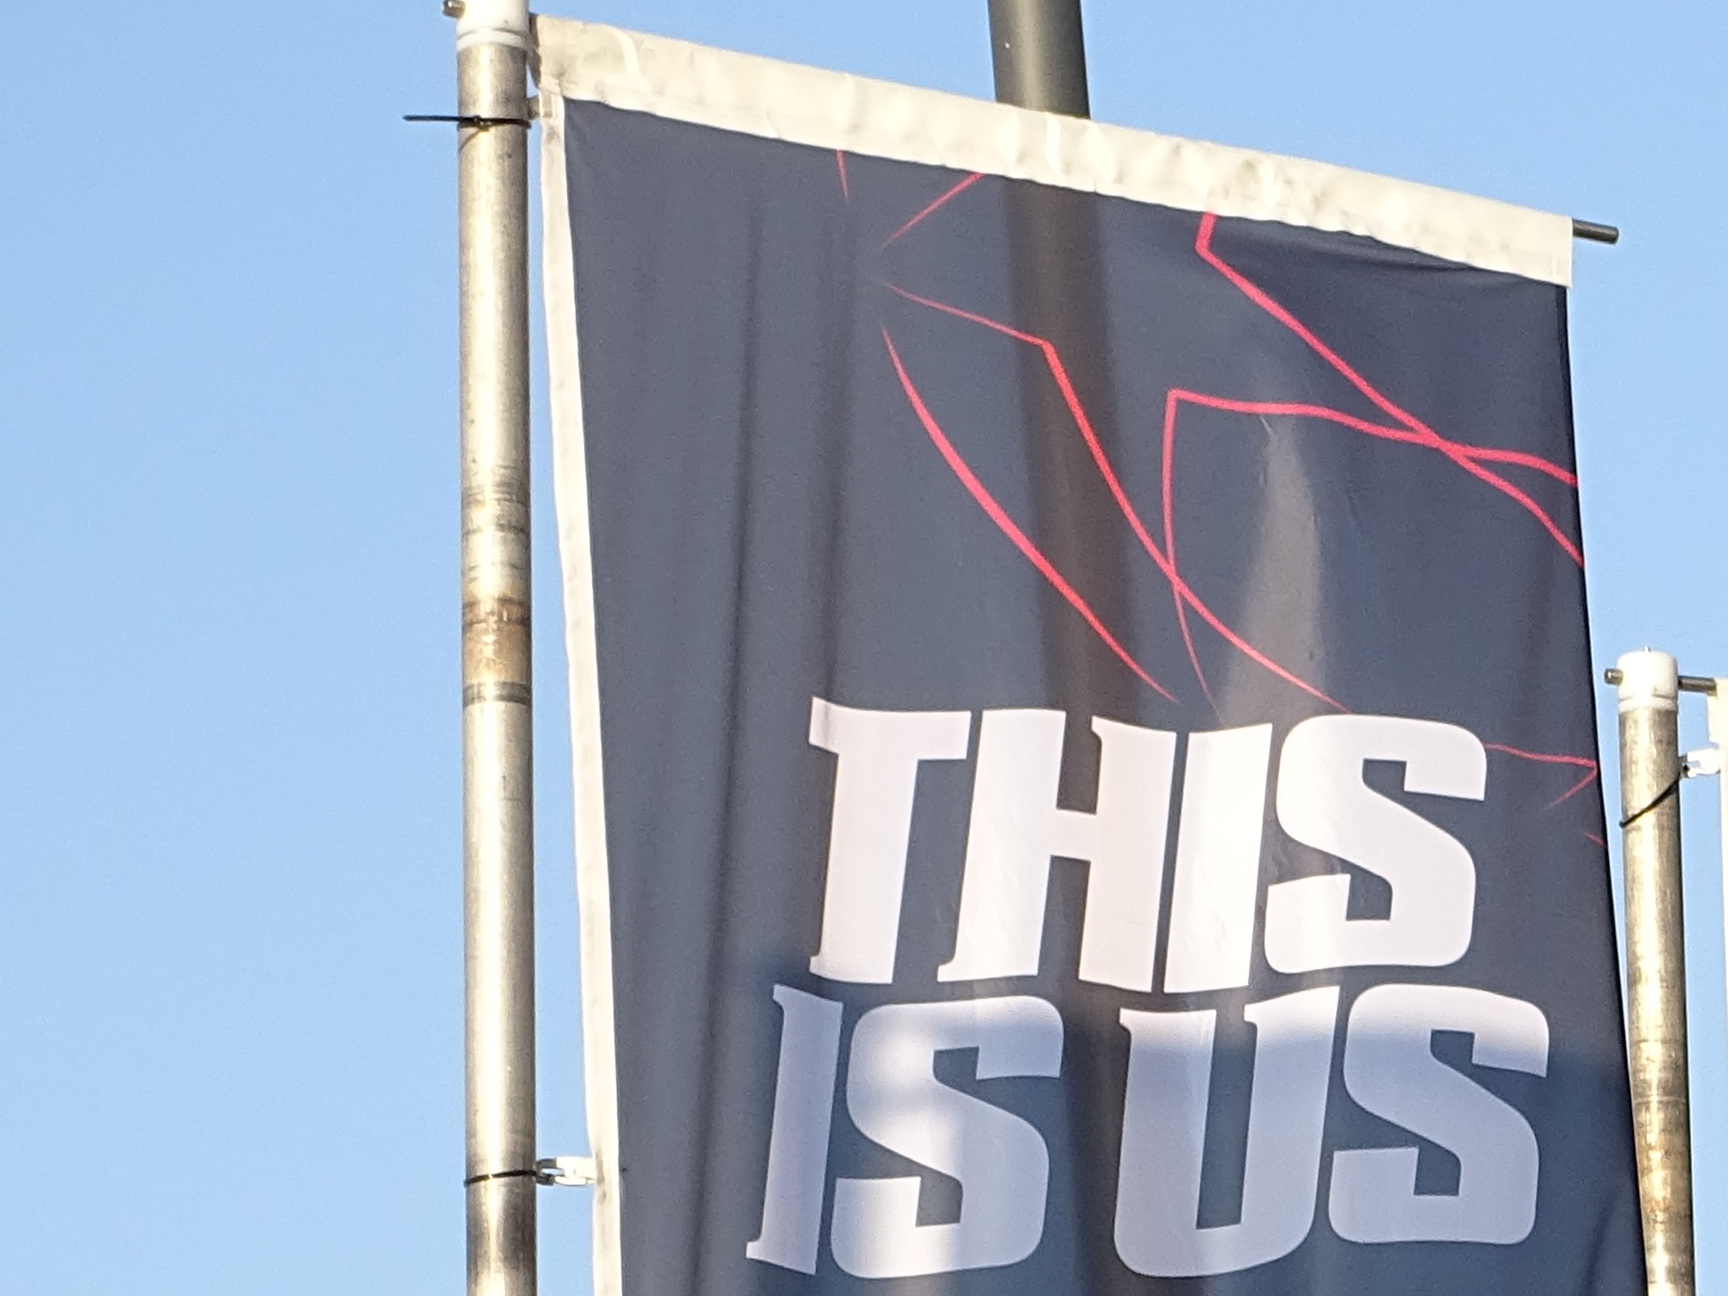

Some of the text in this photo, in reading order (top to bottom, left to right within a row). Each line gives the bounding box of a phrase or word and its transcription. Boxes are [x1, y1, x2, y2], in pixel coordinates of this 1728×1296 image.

[809, 697, 1486, 993] THIS
[746, 984, 1549, 1278] IS US
